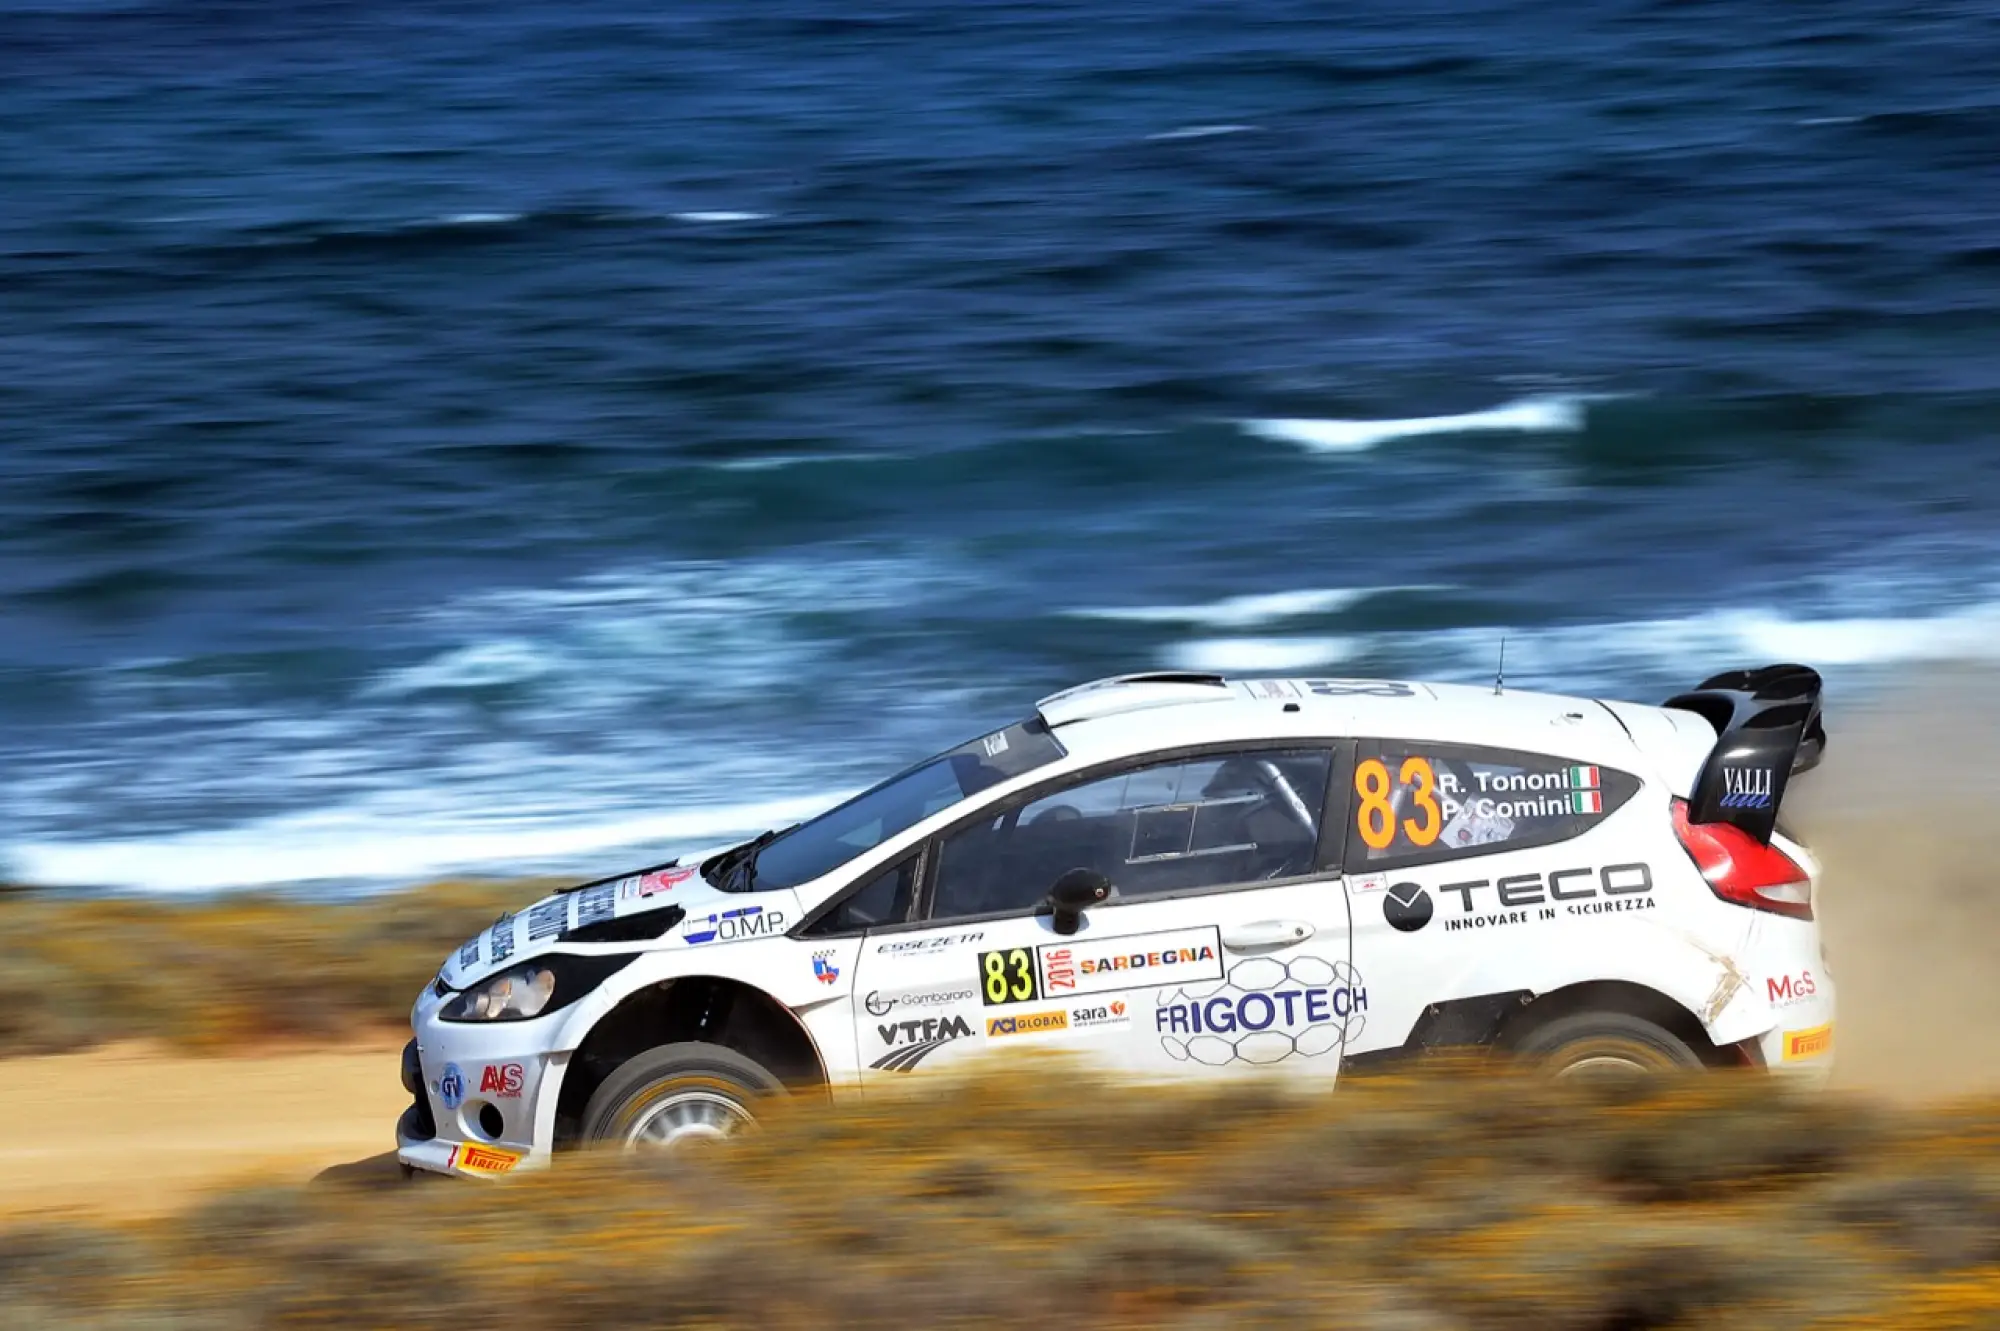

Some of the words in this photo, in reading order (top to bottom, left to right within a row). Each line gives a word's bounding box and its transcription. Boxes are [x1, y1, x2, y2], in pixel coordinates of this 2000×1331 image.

[1439, 774, 1467, 793] R.
[1473, 768, 1569, 792] Tononi
[1723, 768, 1772, 795] VALLI
[1355, 756, 1442, 849] 83
[1475, 793, 1573, 818] Comini
[1439, 862, 1653, 912] TECO
[718, 911, 784, 940] O.M.P.
[1444, 911, 1528, 931] INNOVARE
[1539, 908, 1556, 920] IN
[1567, 897, 1656, 915] SICUREZZA
[1046, 949, 1076, 991] 2016
[1080, 946, 1214, 974] SARDEGNA
[985, 949, 1032, 1003] 83
[1018, 1015, 1065, 1029] GLOBAL
[1072, 1006, 1107, 1022] sara
[1156, 986, 1368, 1034] FRIGOTECH
[877, 1015, 976, 1045] V.T.F.M.
[480, 1063, 523, 1093] AVS
[464, 1147, 517, 1171] PIRELLI
